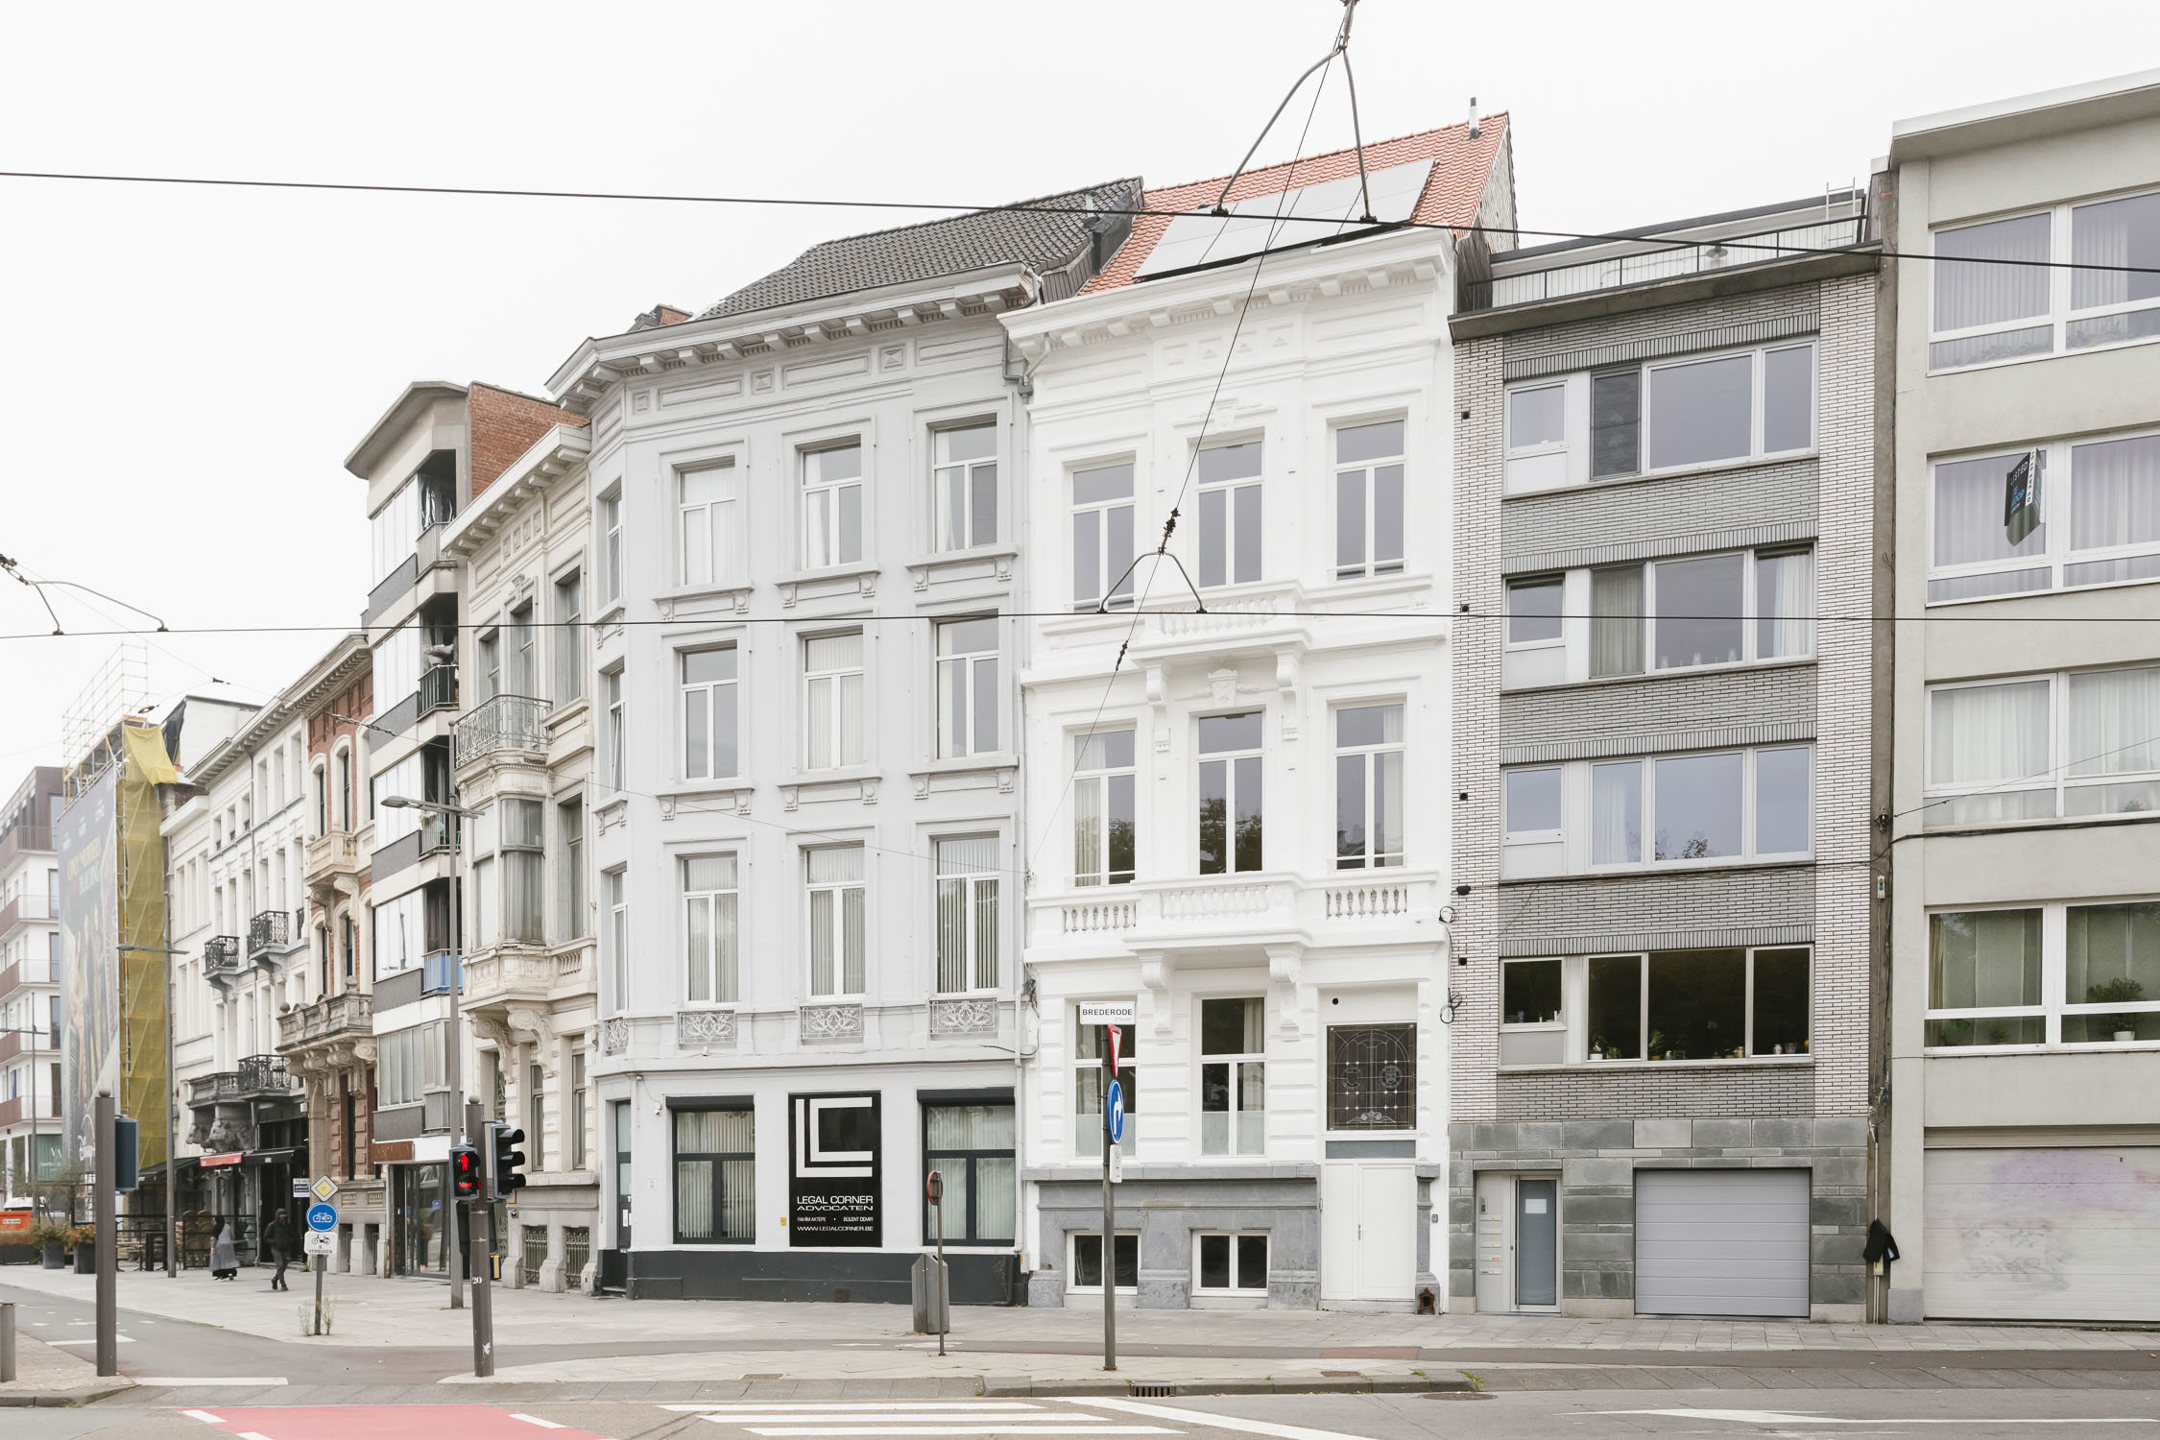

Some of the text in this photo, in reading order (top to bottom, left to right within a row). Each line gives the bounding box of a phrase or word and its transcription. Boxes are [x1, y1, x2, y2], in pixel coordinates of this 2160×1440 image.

[1082, 1008, 1133, 1016] BREDERODE
[796, 1195, 874, 1205] LEGAL CORNER
